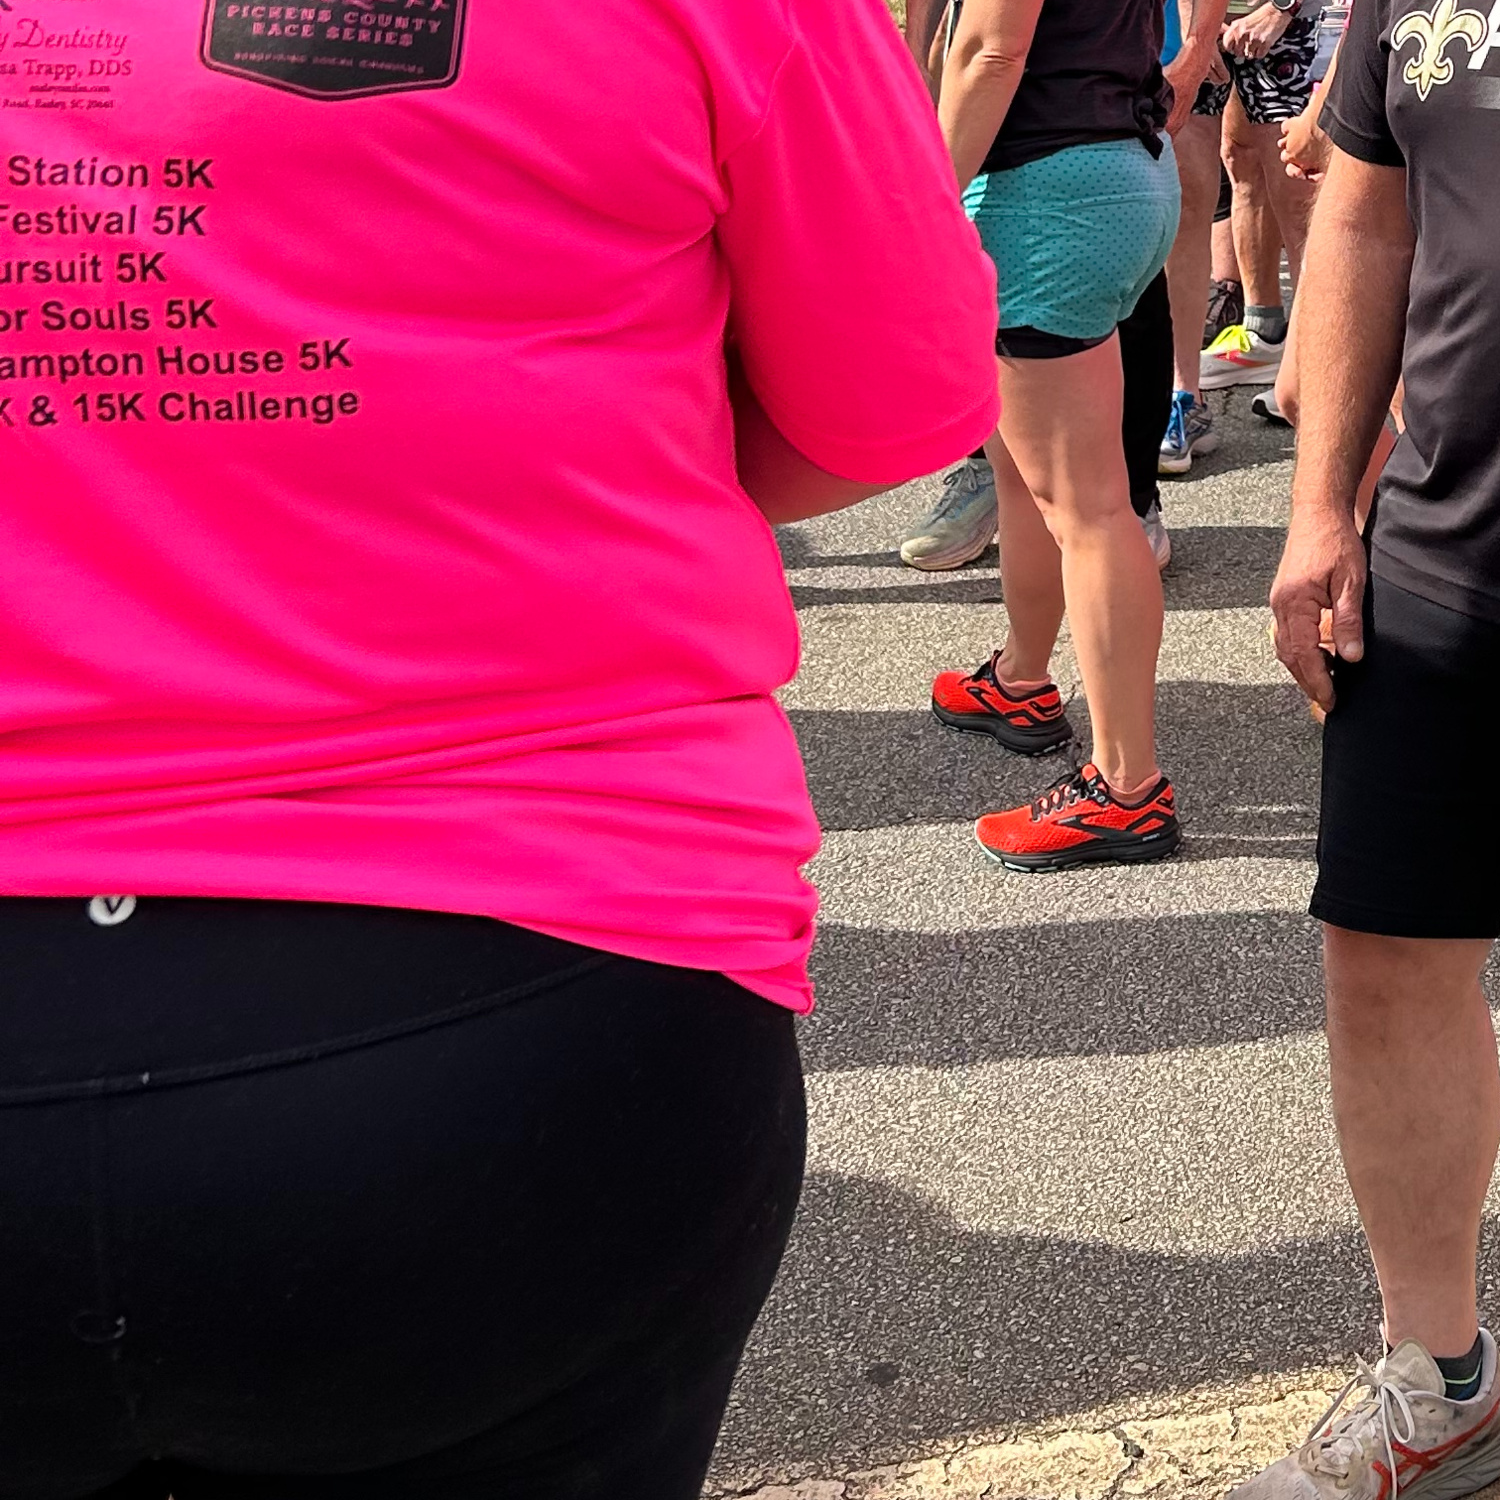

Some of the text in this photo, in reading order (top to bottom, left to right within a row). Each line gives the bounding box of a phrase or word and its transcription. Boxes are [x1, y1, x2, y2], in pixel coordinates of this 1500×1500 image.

[12, 18, 128, 56] Dentistry
[343, 11, 442, 34] COUNTY
[23, 59, 82, 80] Trapp,
[88, 59, 134, 76] DDS
[8, 155, 215, 188] Station 5K
[152, 204, 207, 236] 5K
[0, 251, 167, 284] ursuit 5K
[0, 299, 217, 332] or Souls 5K
[0, 338, 353, 384] ampton House 5K
[28, 395, 57, 427] &
[72, 392, 146, 423] 15K
[159, 390, 359, 425] Challenge
